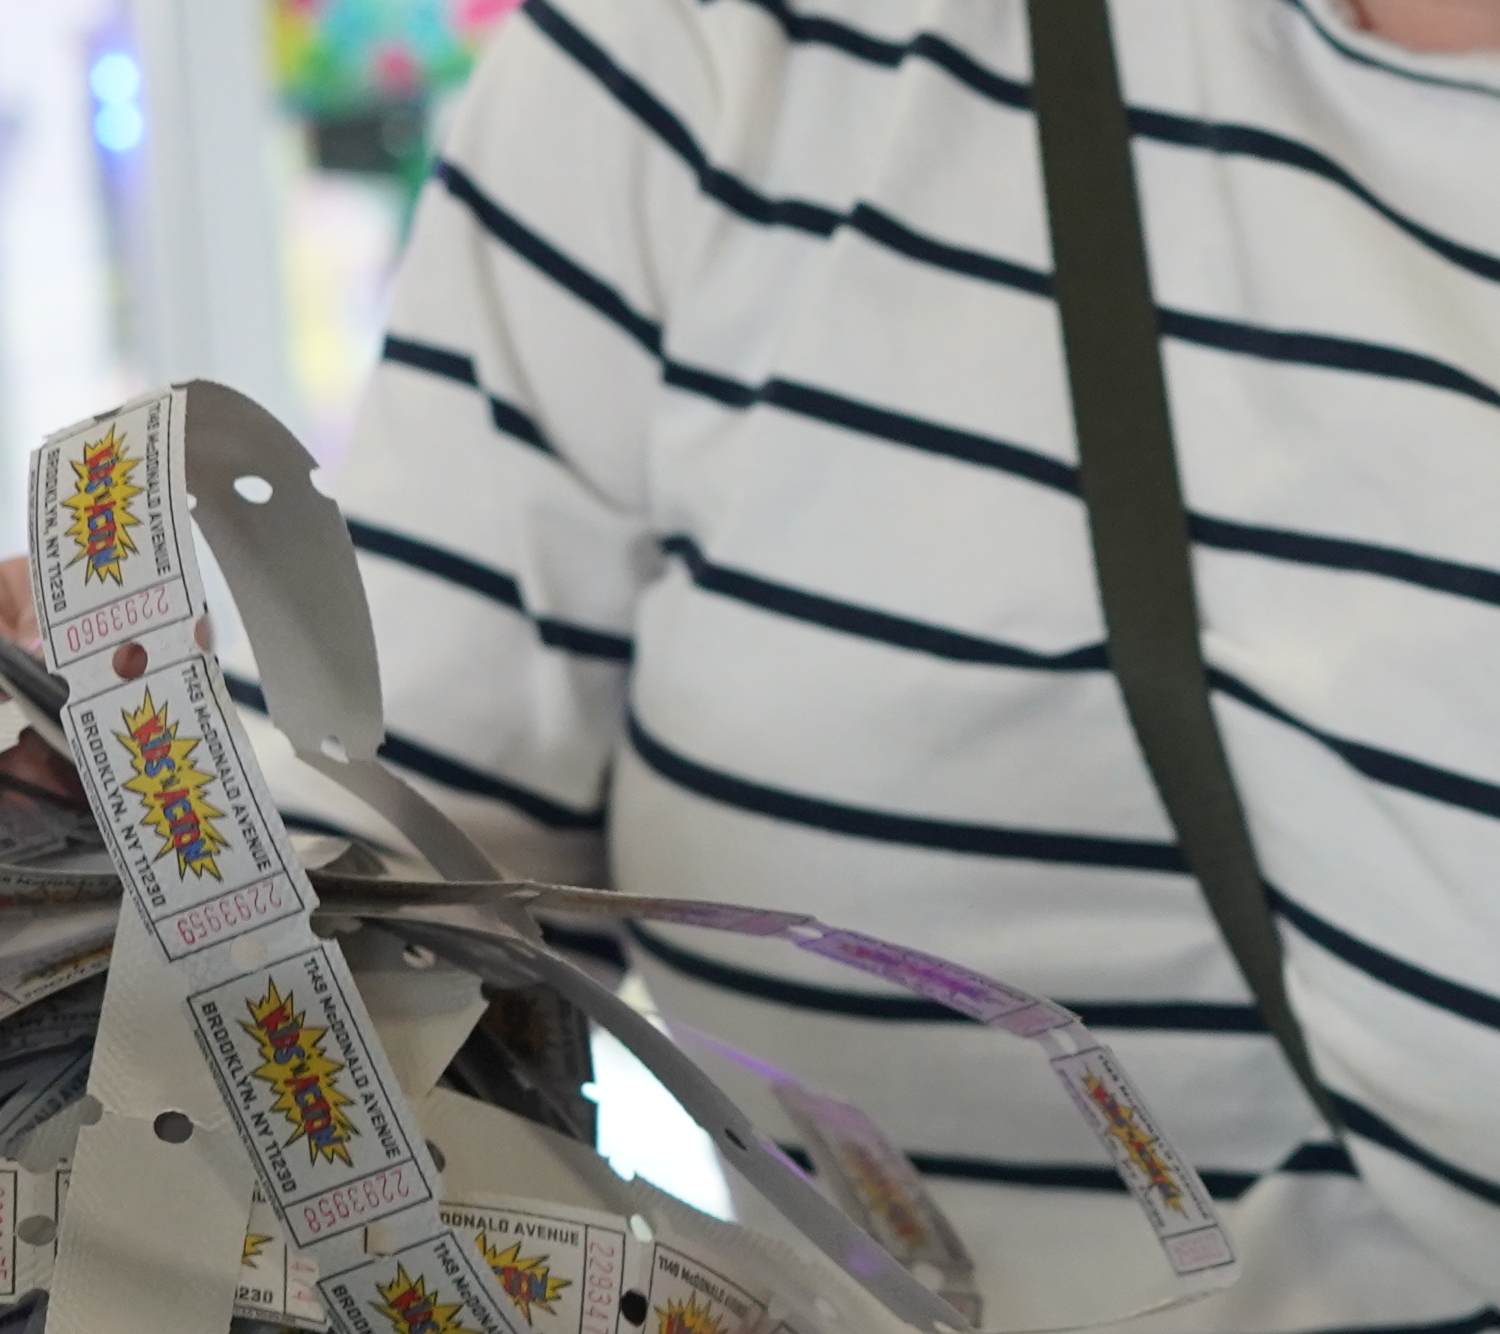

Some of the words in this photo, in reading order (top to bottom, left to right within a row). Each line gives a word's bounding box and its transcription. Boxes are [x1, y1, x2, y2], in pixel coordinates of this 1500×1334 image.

[46, 535, 59, 558] NY
[49, 568, 66, 613] 11230
[150, 514, 170, 575] AVENUE
[80, 710, 127, 823] BROOKLYN,
[121, 823, 143, 851] NY
[135, 853, 166, 907] 11230
[131, 714, 175, 777] KIDS
[154, 788, 213, 862] ACTION
[195, 705, 240, 801] McDONALD
[233, 799, 272, 872] AVENUE
[202, 1001, 257, 1110] BROOKLYN,
[251, 1111, 274, 1137] NY
[265, 1139, 297, 1195] 11230
[258, 1004, 305, 1065] KIDS
[284, 1075, 344, 1149] ACTION
[320, 995, 370, 1091] McDONALD
[360, 1089, 400, 1159] AVENUE
[514, 1222, 579, 1246] AVENUE
